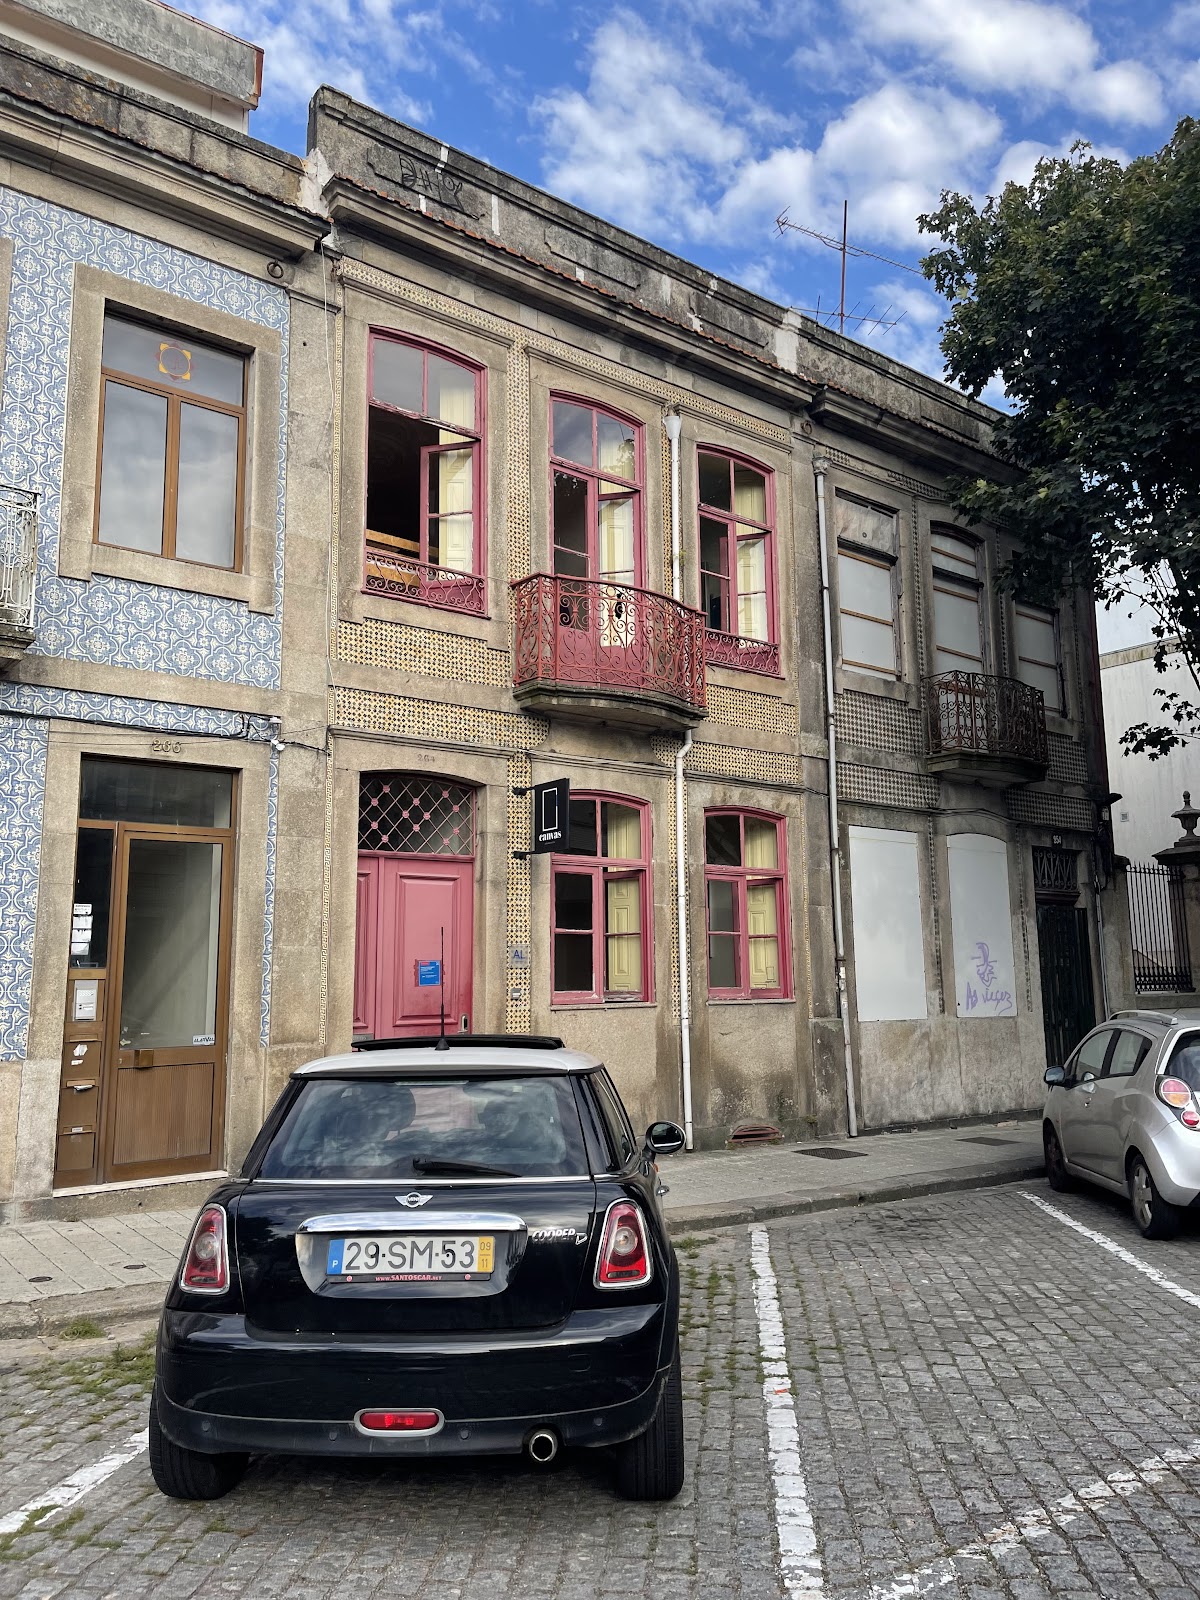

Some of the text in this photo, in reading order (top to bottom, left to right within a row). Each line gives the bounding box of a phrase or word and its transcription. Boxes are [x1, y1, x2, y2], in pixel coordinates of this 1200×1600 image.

[152, 738, 181, 754] 266
[538, 830, 562, 842] canvas
[513, 949, 526, 960] AL
[479, 1241, 492, 1251] 09
[332, 1259, 339, 1268] P
[481, 1258, 488, 1268] 11
